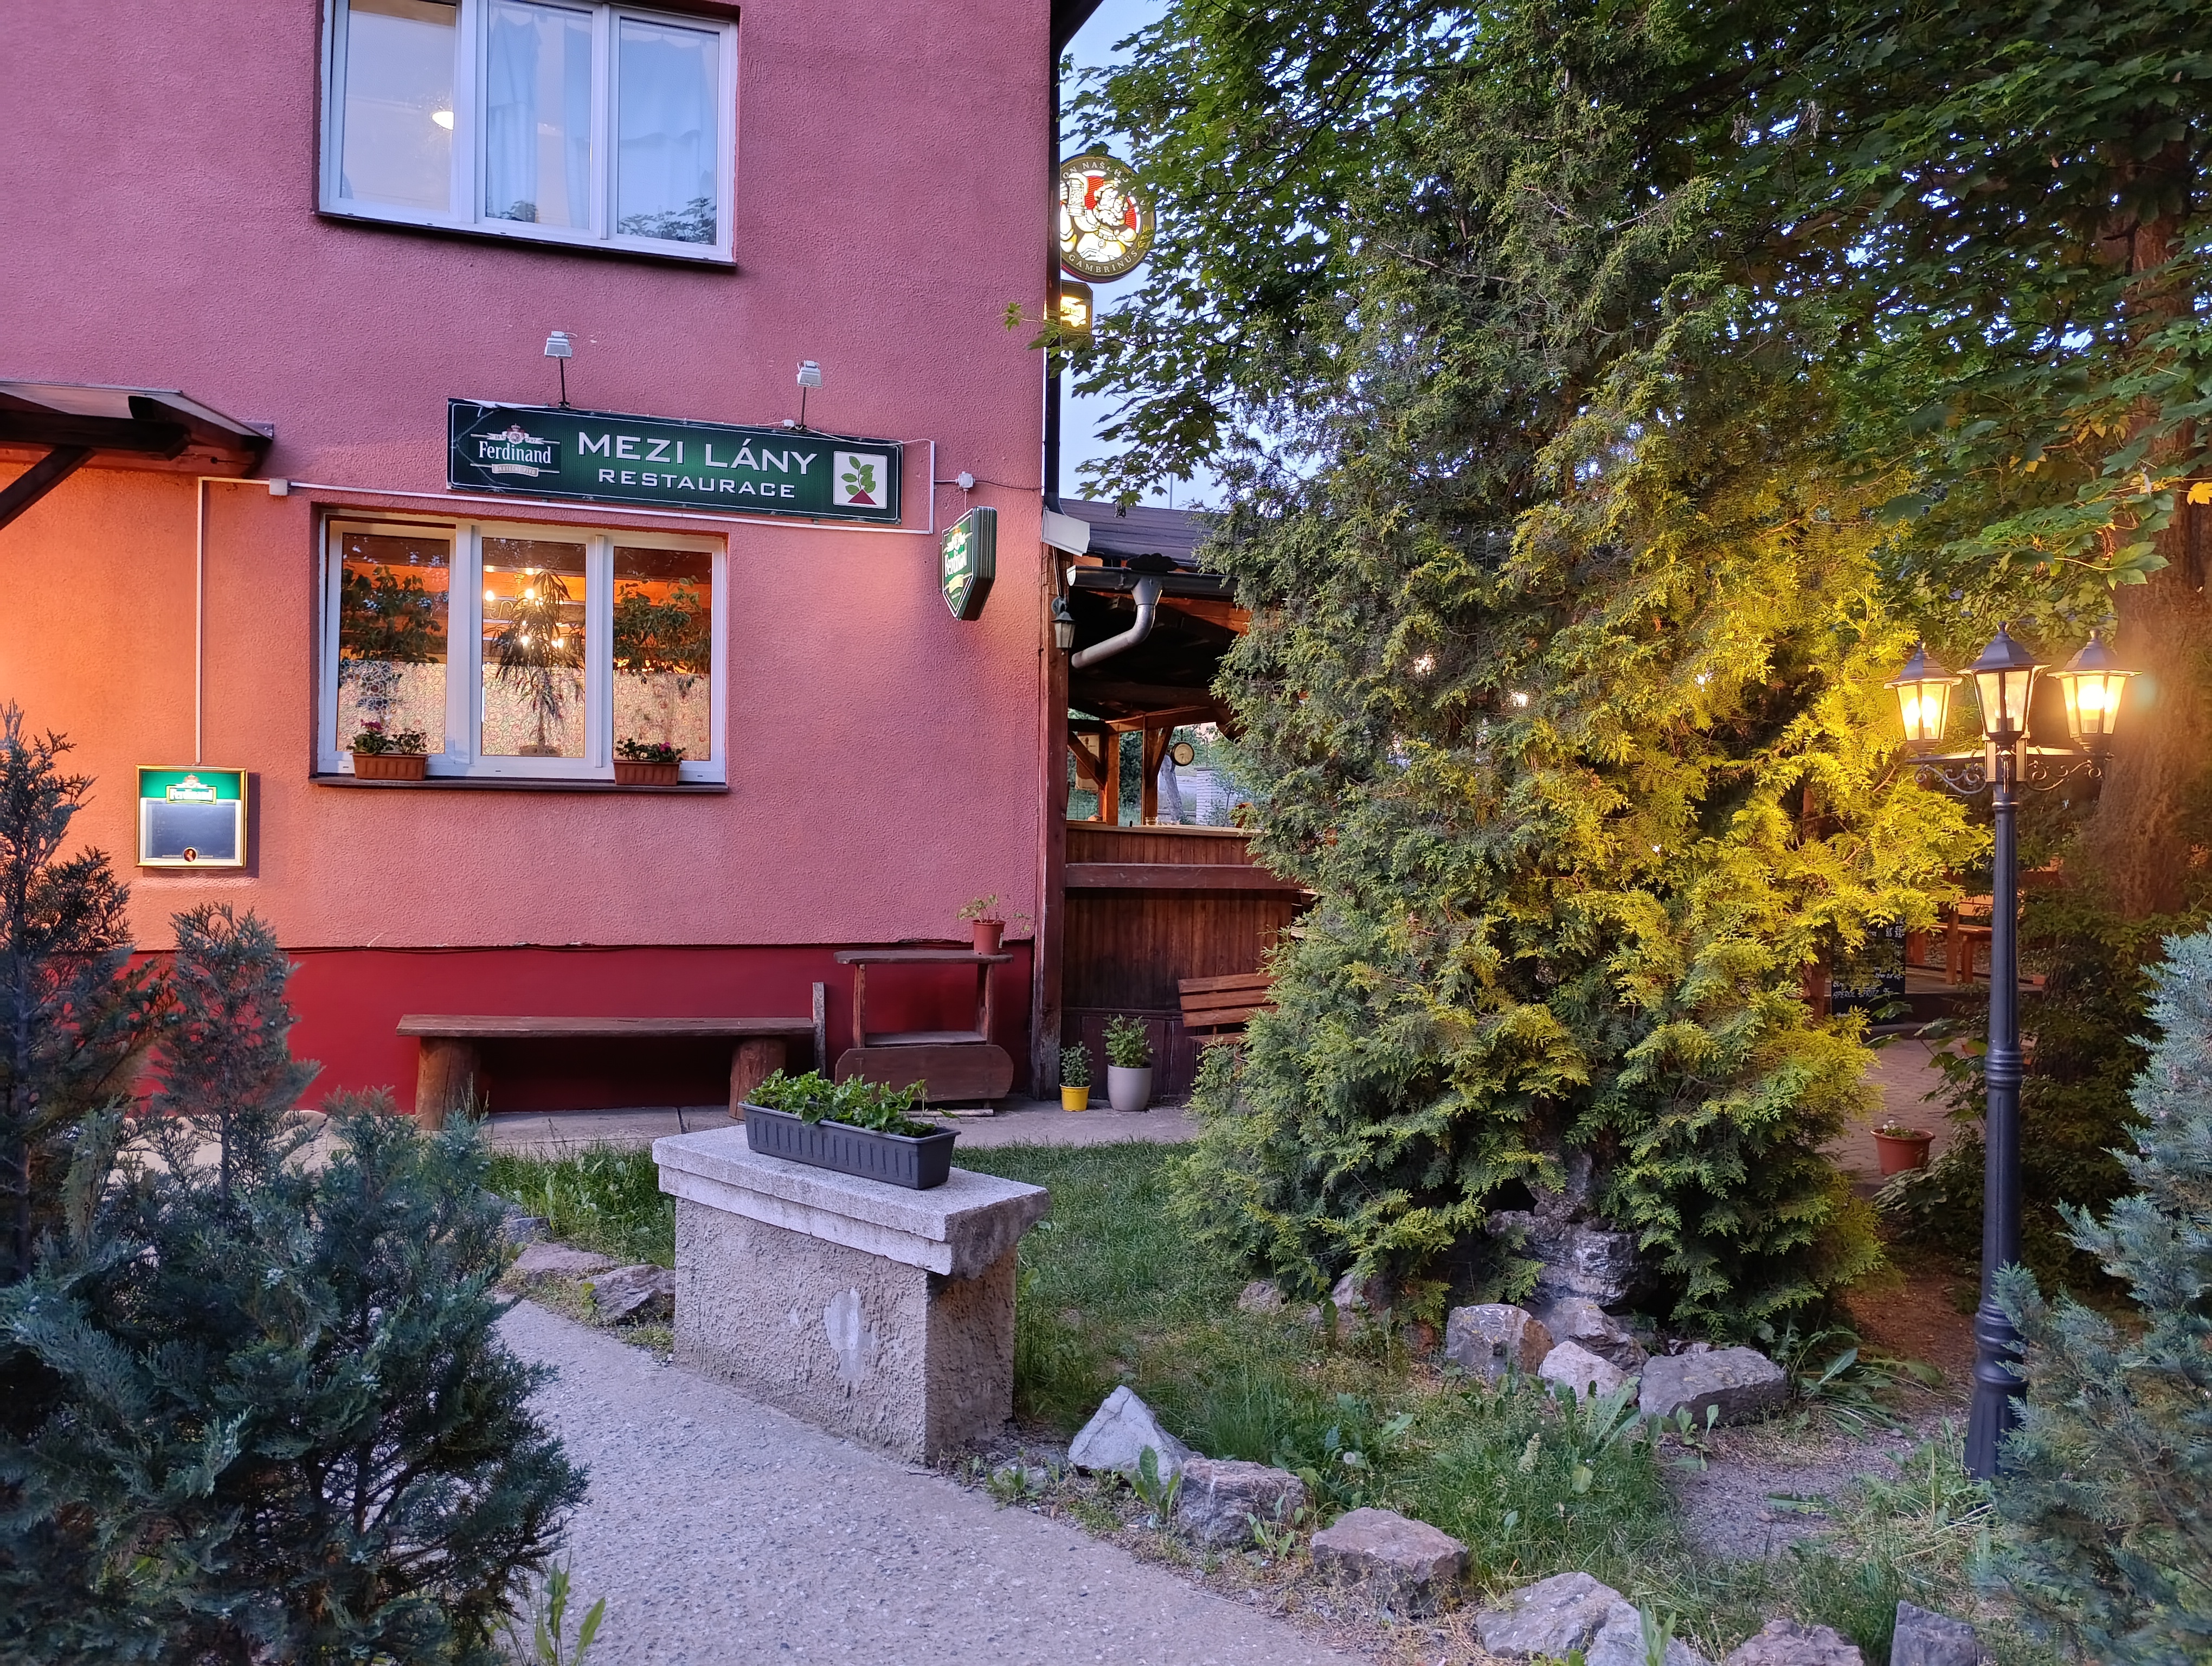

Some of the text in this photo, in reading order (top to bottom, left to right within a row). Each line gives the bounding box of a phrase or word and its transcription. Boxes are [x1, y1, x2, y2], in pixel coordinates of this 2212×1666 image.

[1068, 249, 1137, 274] GAMBRINUS
[479, 440, 552, 464] Ferdinand
[578, 432, 818, 475] MEZI LÁNY
[598, 468, 795, 498] RESTAURACE
[1832, 990, 1856, 999] APEROL
